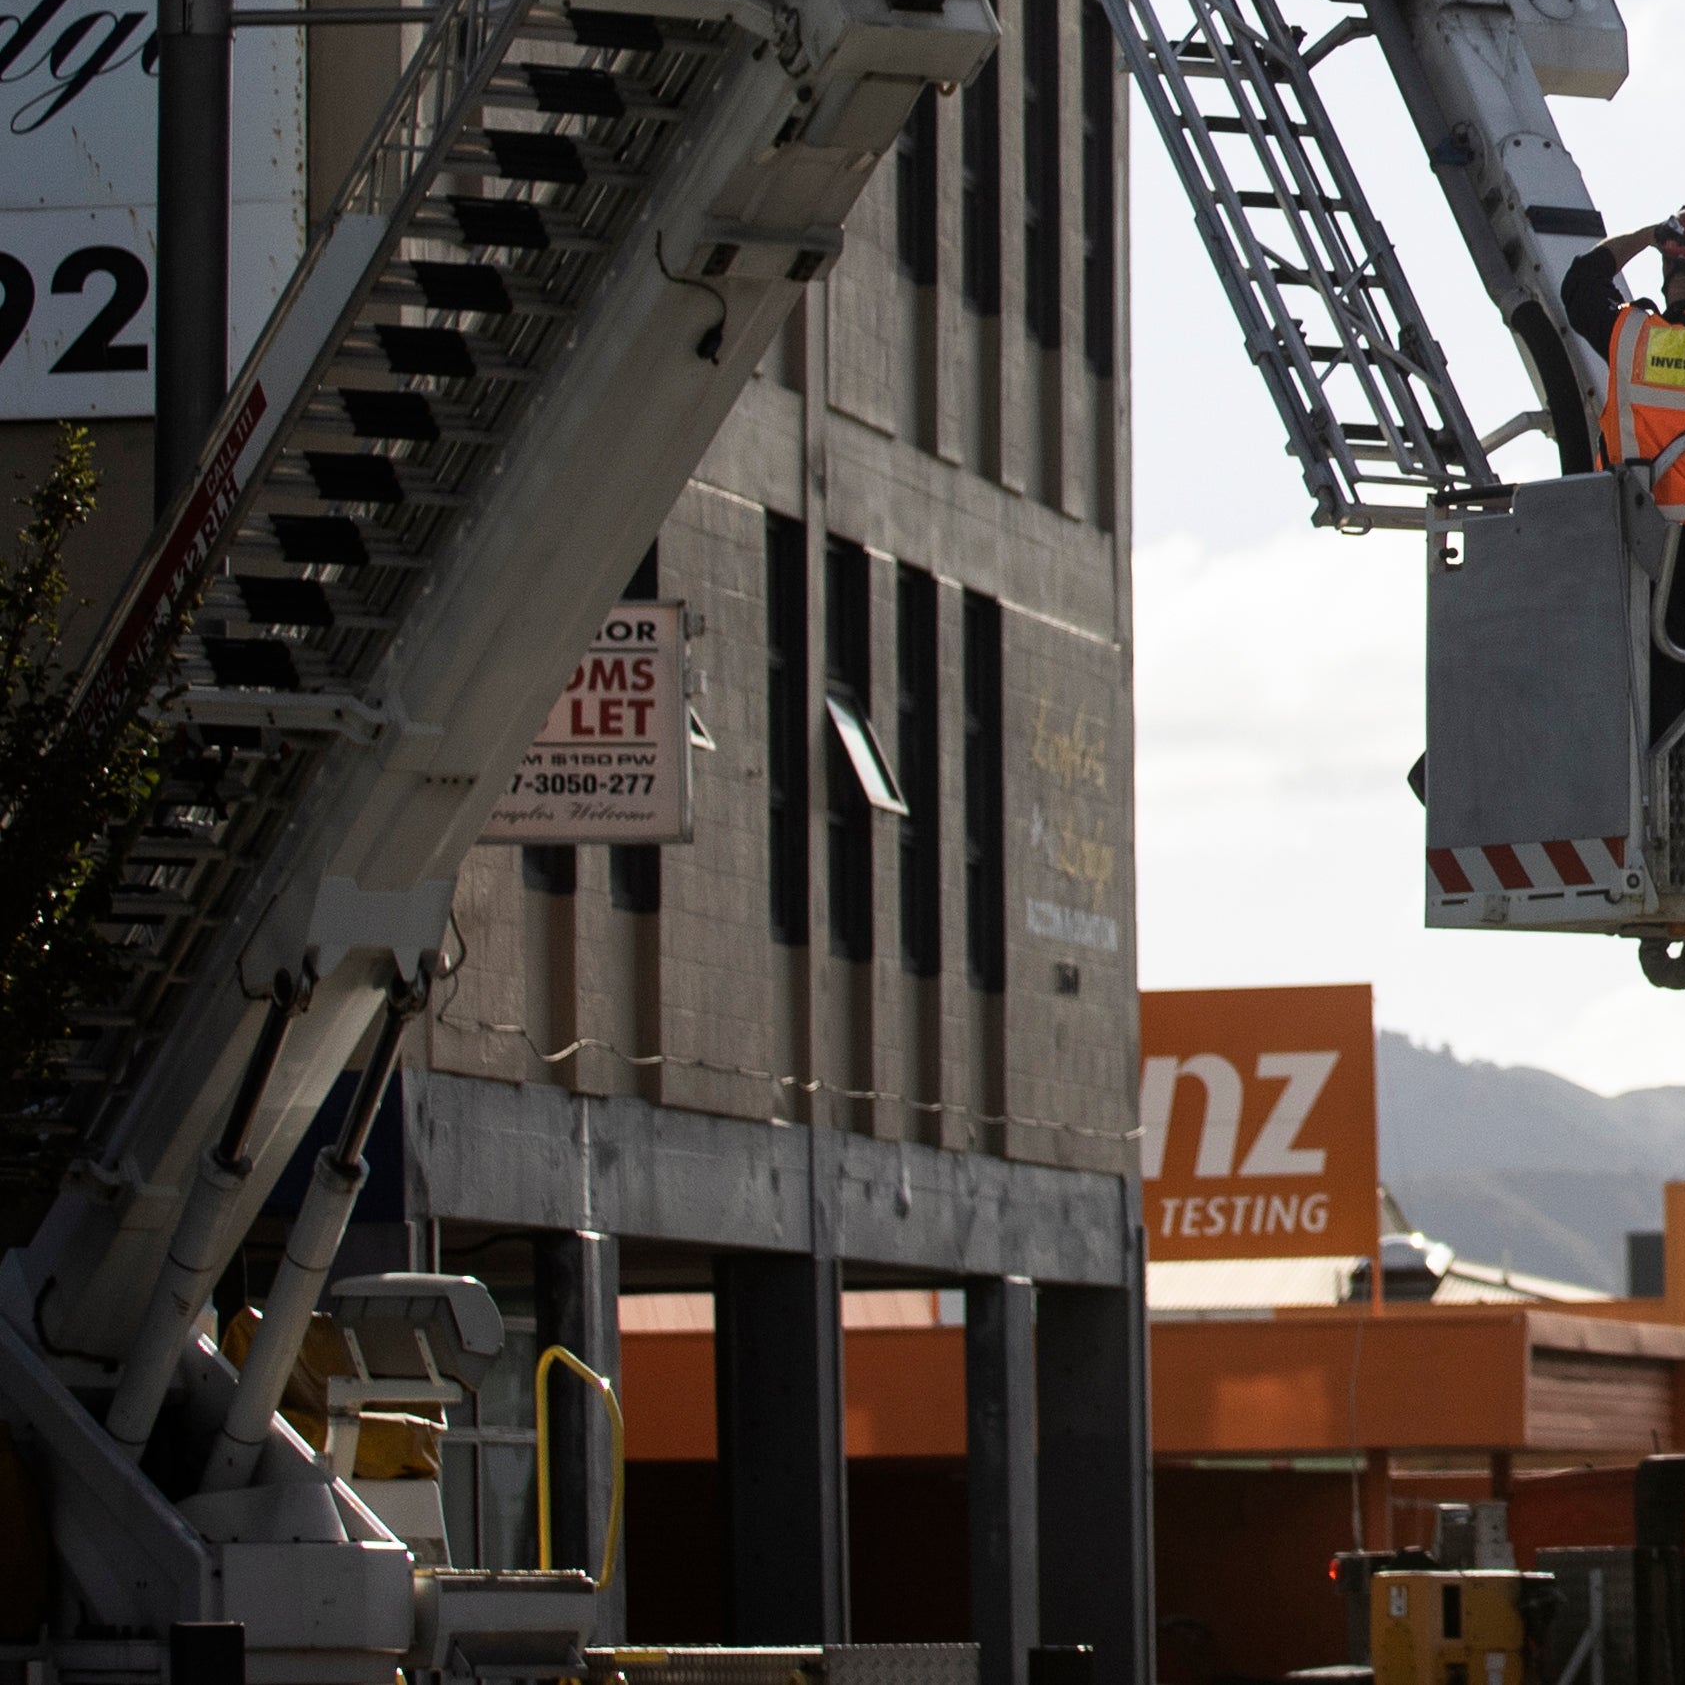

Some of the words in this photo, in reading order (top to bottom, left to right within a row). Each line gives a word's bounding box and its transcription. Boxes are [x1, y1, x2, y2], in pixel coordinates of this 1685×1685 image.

[205, 441, 237, 497] CALL
[234, 410, 255, 439] 111
[596, 621, 656, 641] OR
[571, 699, 655, 736] LET
[1161, 1192, 1328, 1237] TESTING
